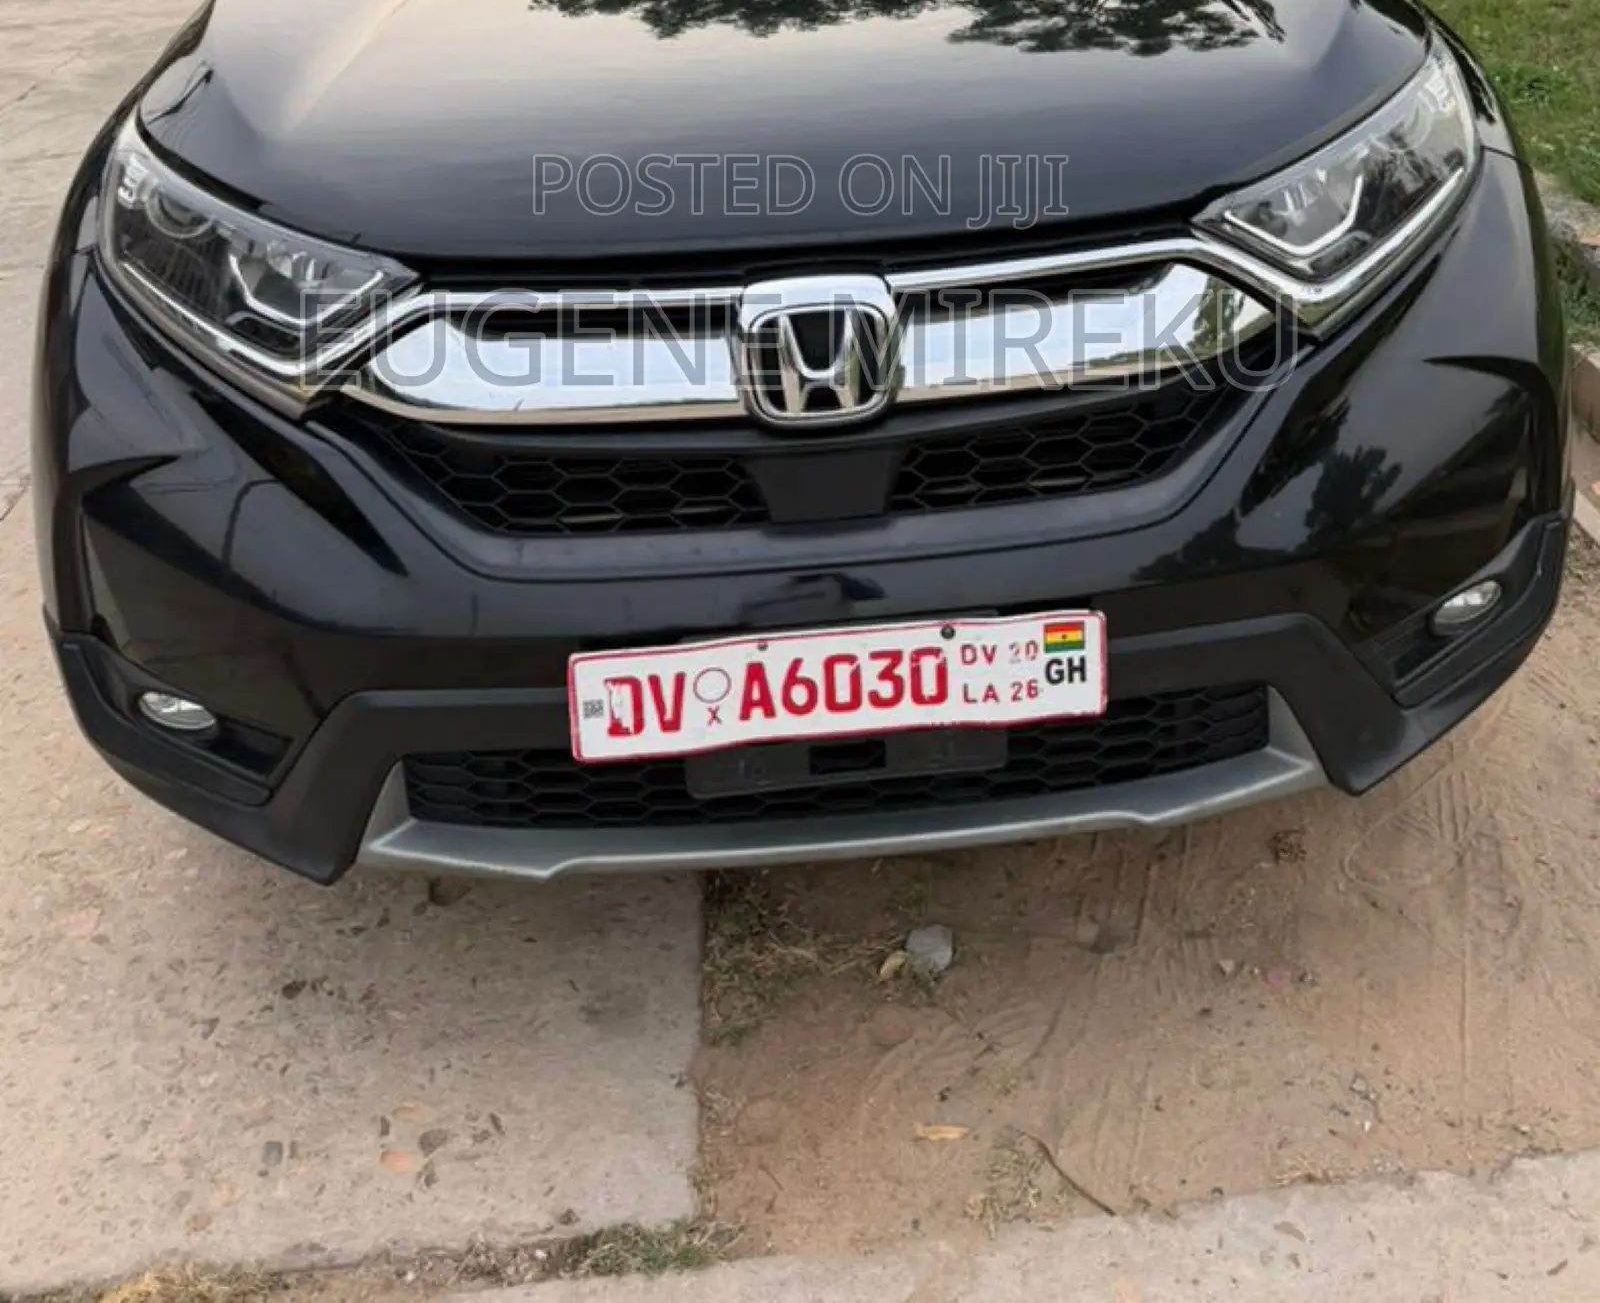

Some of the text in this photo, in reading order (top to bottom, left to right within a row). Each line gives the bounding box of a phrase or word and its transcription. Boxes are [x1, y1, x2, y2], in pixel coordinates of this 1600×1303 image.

[960, 643, 998, 666] DV
[1044, 655, 1087, 685] GH
[604, 646, 949, 738] DV A6030
[963, 678, 1038, 704] LA 26
